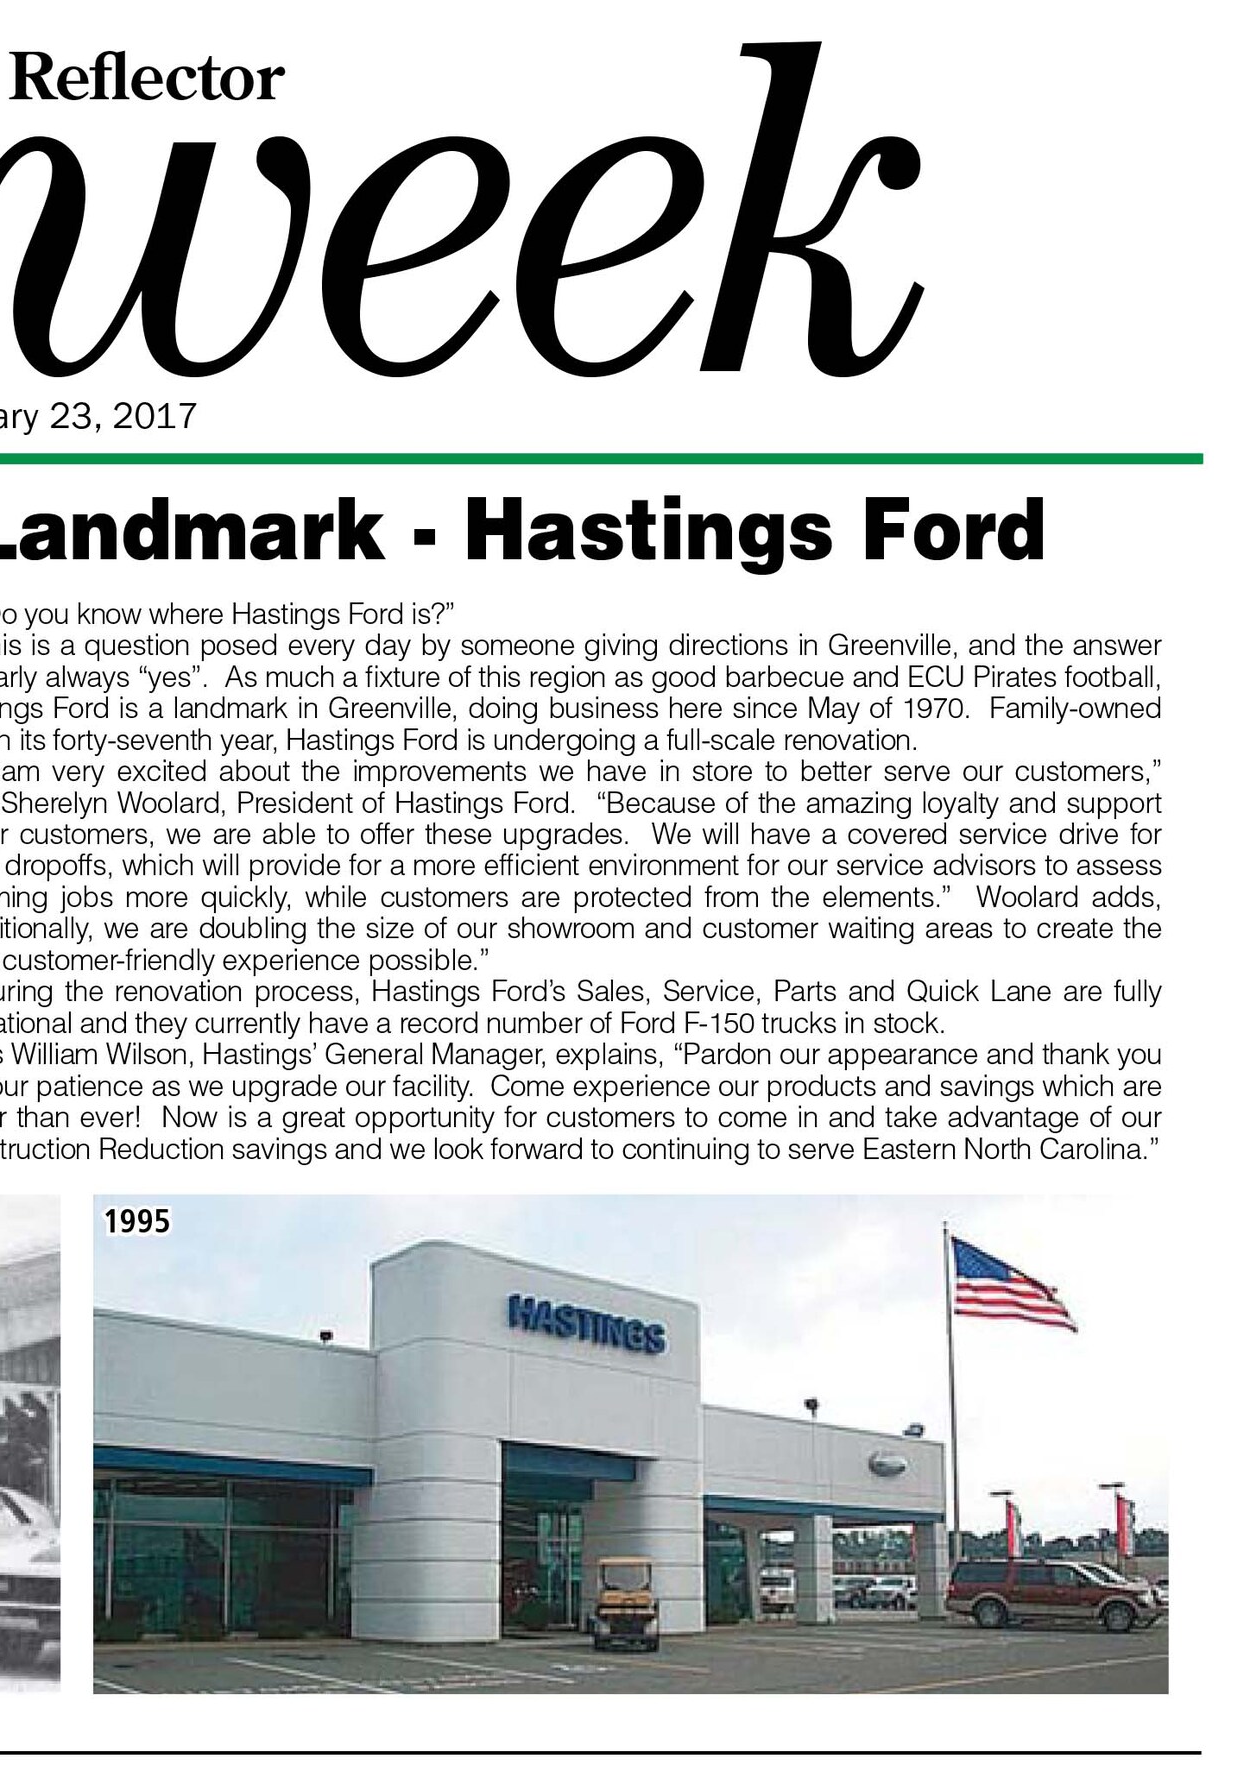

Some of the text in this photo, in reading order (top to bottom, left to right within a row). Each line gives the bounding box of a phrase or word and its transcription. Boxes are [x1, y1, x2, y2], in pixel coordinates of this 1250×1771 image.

[8, 50, 286, 101] Reflector
[50, 401, 101, 434] 23,
[113, 401, 197, 430] 2017
[413, 528, 436, 546] -
[467, 494, 833, 577] Hastings
[865, 496, 1044, 561] Ford
[24, 607, 69, 631] you
[77, 601, 142, 625] know
[148, 601, 224, 625] where
[232, 601, 341, 631] Hastings
[349, 601, 403, 625] Ford
[412, 601, 454, 625] is?”
[31, 632, 50, 656] is
[60, 638, 76, 656] a
[84, 632, 189, 662] question
[201, 632, 277, 662] posed
[288, 638, 356, 662] every
[365, 632, 412, 662] day
[422, 632, 451, 662] by
[461, 638, 575, 656] someone
[584, 632, 658, 662] giving
[669, 632, 789, 656] directions
[799, 632, 818, 656] in
[828, 632, 958, 660] Greenville,
[968, 632, 1015, 656] and
[1024, 632, 1064, 656] the
[1073, 638, 1163, 656] answer
[54, 695, 109, 719] Ford
[119, 695, 139, 719] is
[148, 701, 164, 719] a
[174, 695, 288, 719] landmark
[298, 695, 318, 719] in
[328, 695, 457, 723] Greenville,
[468, 695, 538, 725] doing
[550, 695, 659, 719] business
[669, 695, 723, 719] here
[733, 695, 798, 719] since
[808, 695, 861, 725] May
[869, 695, 893, 719] of
[904, 697, 970, 719] 1970.
[990, 695, 1161, 725] Family-owned
[1, 764, 40, 782] am
[51, 764, 105, 788] very
[117, 758, 207, 782] excited
[219, 758, 291, 782] about
[301, 758, 340, 782] the
[353, 758, 527, 788] improvements
[538, 764, 574, 782] we
[587, 758, 647, 782] have
[660, 758, 680, 782] in
[692, 760, 753, 782] store
[764, 760, 788, 782] to
[801, 758, 873, 782] better
[884, 764, 951, 782] serve
[962, 764, 1004, 782] our
[1015, 758, 1161, 786] customers,”
[5, 852, 112, 882] dropoffs,
[121, 852, 194, 876] which
[202, 852, 239, 876] will
[249, 852, 341, 882] provide
[348, 852, 383, 876] for
[390, 859, 406, 876] a
[413, 859, 476, 876] more
[484, 852, 580, 876] efficient
[588, 852, 740, 876] environment
[746, 853, 780, 876] for
[787, 858, 829, 876] our
[836, 852, 924, 876] service
[933, 852, 1036, 876] advisors
[1044, 854, 1068, 876] to
[1076, 859, 1162, 876] assess
[2, 947, 216, 977] customer-friendly
[222, 947, 360, 977] experience
[369, 947, 489, 977] possible.”
[64, 978, 104, 1002] the
[115, 978, 242, 1002] renovation
[255, 984, 359, 1008] process,
[372, 978, 480, 1008] Hastings
[492, 978, 566, 1002] Ford’s
[577, 978, 650, 1006] Sales,
[663, 978, 761, 1006] Service,
[775, 978, 837, 1002] Parts
[848, 978, 895, 1002] and
[907, 978, 980, 1003] Quick
[991, 978, 1052, 1002] Lane
[1063, 985, 1103, 1002] are
[1113, 978, 1163, 1008] fully
[37, 1073, 143, 1103] patience
[152, 1079, 181, 1097] as
[188, 1079, 224, 1097] we
[232, 1073, 338, 1103] upgrade
[345, 1079, 387, 1097] our
[392, 1073, 473, 1103] facility.
[490, 1073, 565, 1097] Come
[573, 1073, 711, 1103] experience
[718, 1079, 760, 1097] our
[767, 1073, 877, 1103] products
[884, 1073, 931, 1097] and
[940, 1073, 1035, 1103] savings
[1042, 1073, 1114, 1097] which
[1123, 1079, 1162, 1097] are
[99, 1136, 224, 1160] Reduction
[232, 1136, 328, 1166] savings
[335, 1136, 382, 1160] and
[389, 1142, 426, 1160] we
[434, 1136, 484, 1160] look
[490, 1136, 583, 1160] forward
[590, 1138, 614, 1160] to
[622, 1136, 750, 1166] continuing
[757, 1138, 781, 1160] to
[788, 1142, 855, 1160] serve
[863, 1136, 956, 1160] Eastern
[964, 1136, 1031, 1160] North
[1040, 1136, 1159, 1160] Carolina.”
[507, 1292, 667, 1354] HASTINGS
